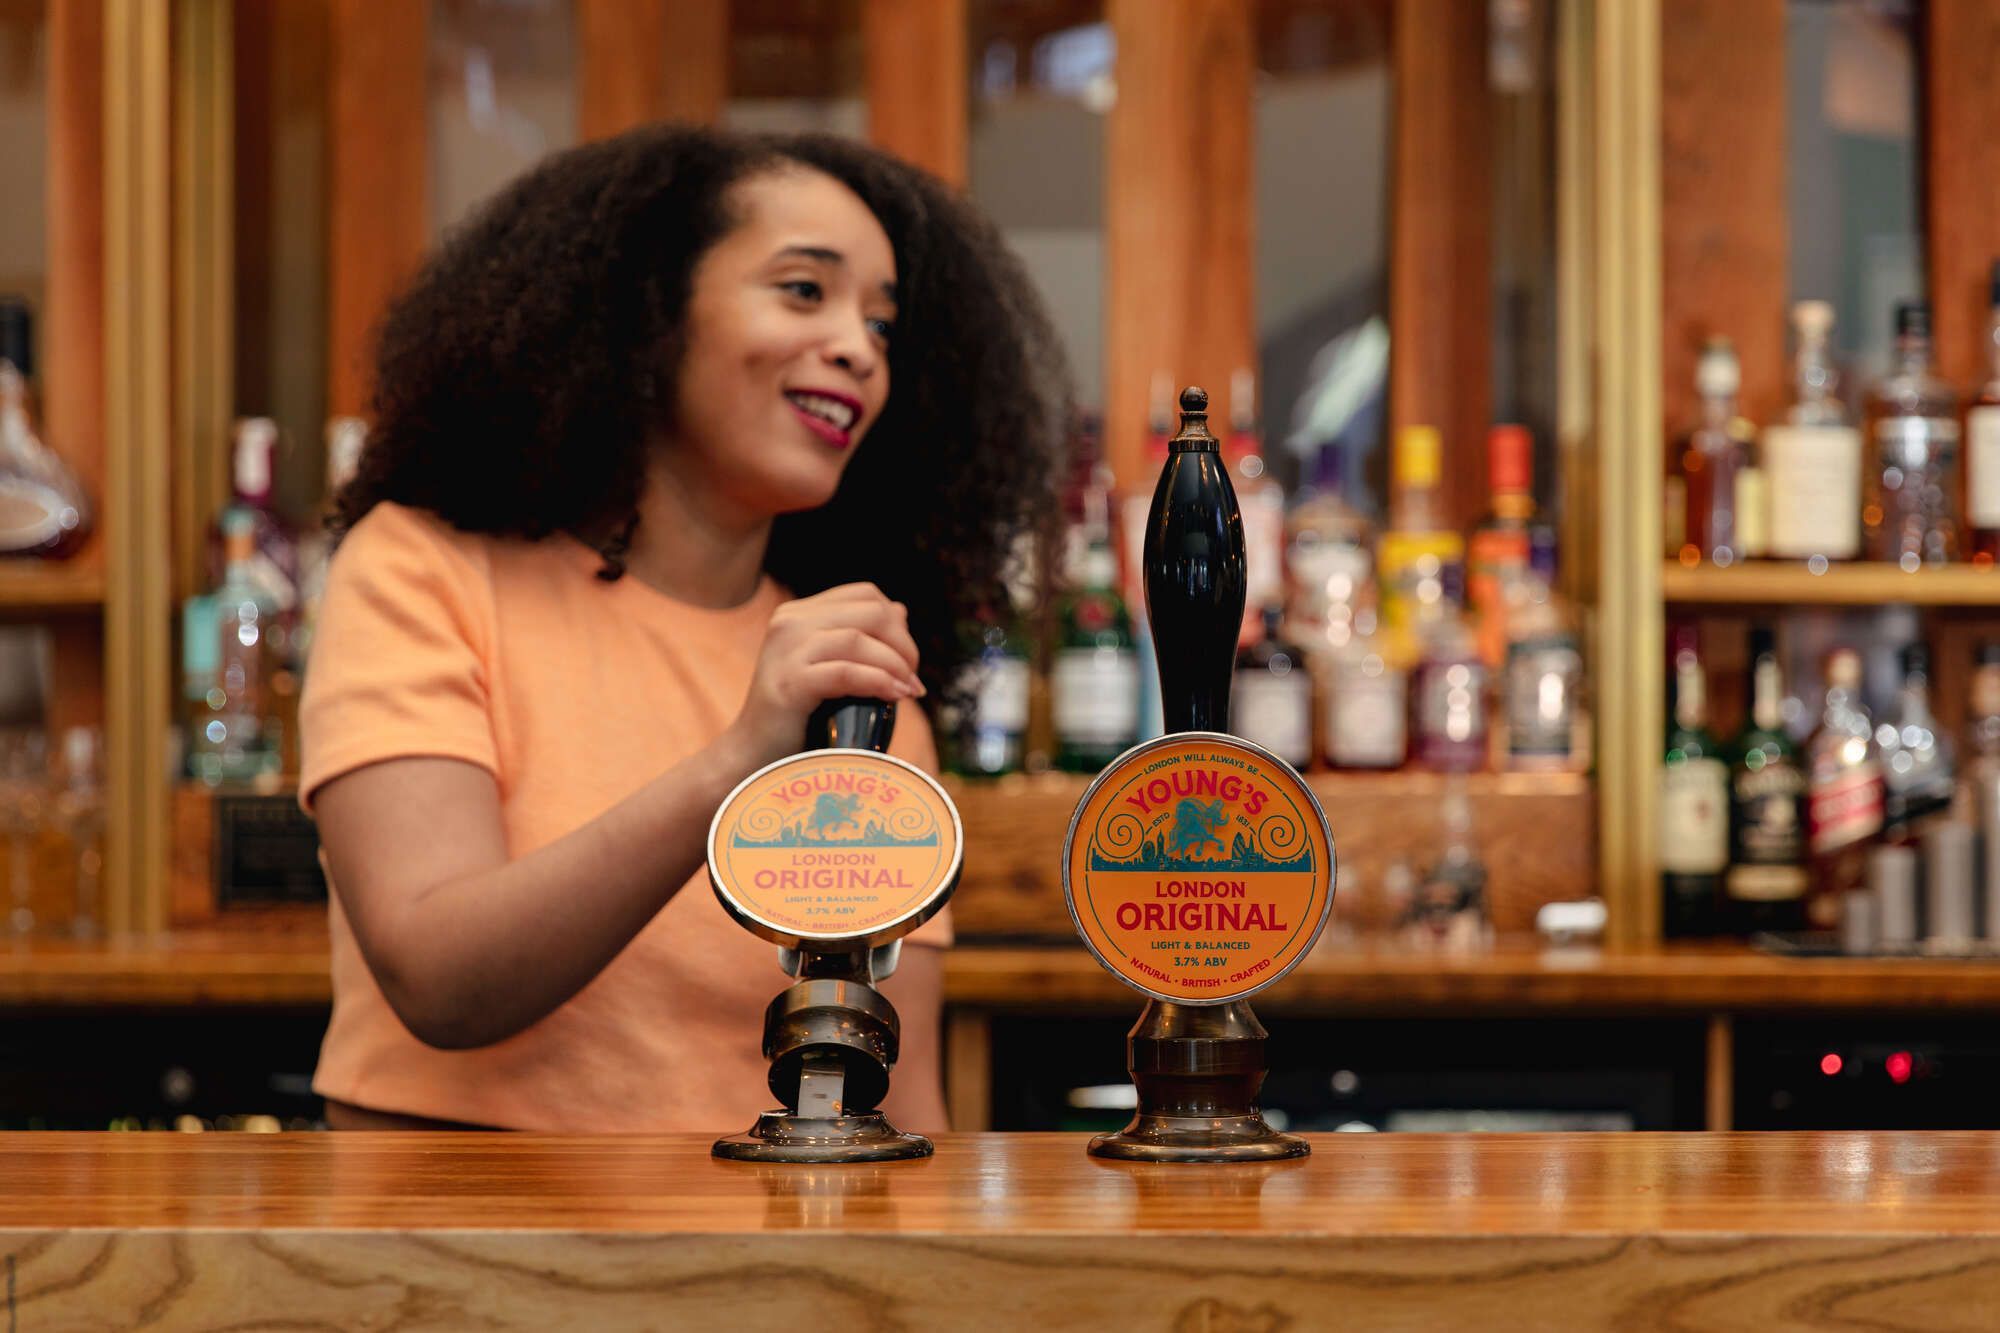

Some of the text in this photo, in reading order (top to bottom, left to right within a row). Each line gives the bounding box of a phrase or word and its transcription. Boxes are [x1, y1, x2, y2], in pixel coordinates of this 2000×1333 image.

[1143, 754, 1259, 775] LONDON WILL ALWAYS BE
[770, 773, 901, 804] YOUNG'S
[1126, 769, 1269, 816] YOUNG'S
[792, 853, 876, 866] LONDON
[754, 868, 913, 889] ORIGINAL
[1156, 881, 1245, 898] LONDON
[1116, 902, 1287, 931] ORIGINAL
[1151, 941, 1250, 950] LIGHT & BALANCED
[1130, 957, 1271, 988] NATURAL BRITISH CRAFTED
[1174, 957, 1228, 967] 3.7% ABV
